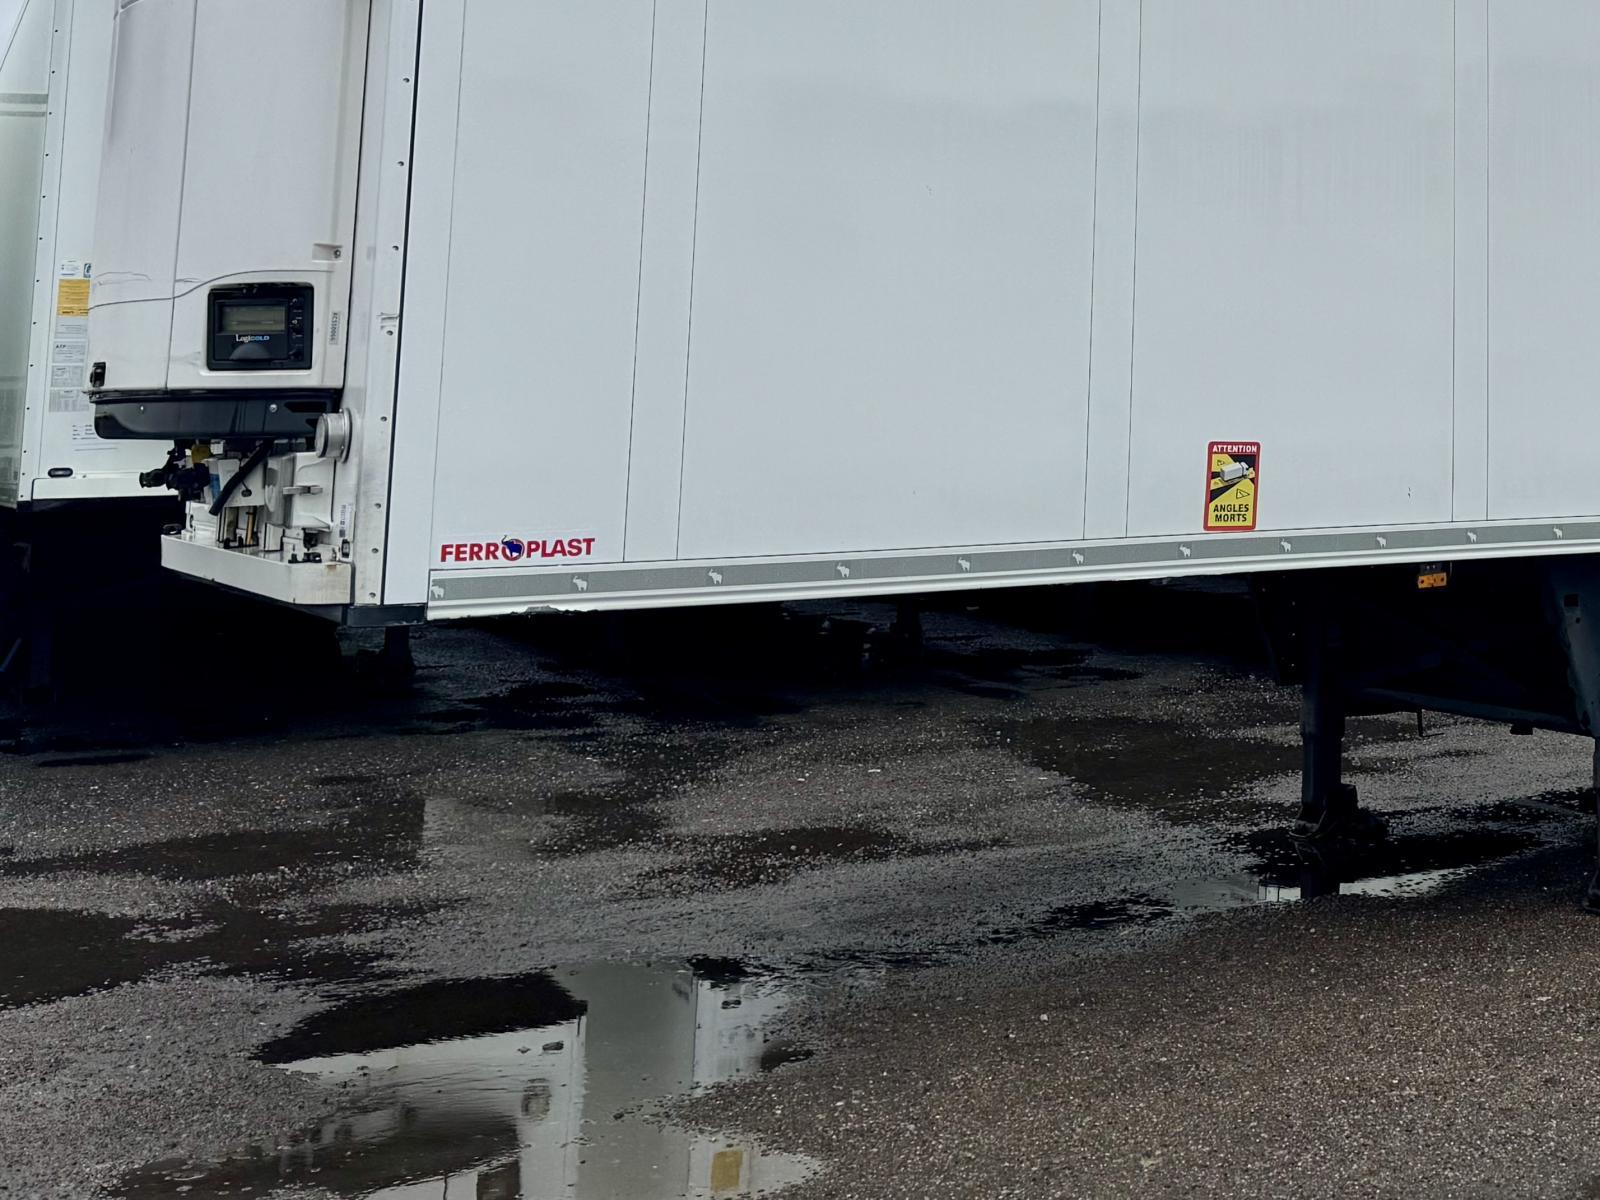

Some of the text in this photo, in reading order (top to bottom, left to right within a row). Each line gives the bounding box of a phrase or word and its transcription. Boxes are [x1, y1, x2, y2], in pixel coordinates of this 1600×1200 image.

[1212, 445, 1257, 453] ATTENTION
[1213, 504, 1249, 513] ANGLES
[1215, 514, 1247, 522] MORTS
[440, 535, 595, 562] FERROPLAST
